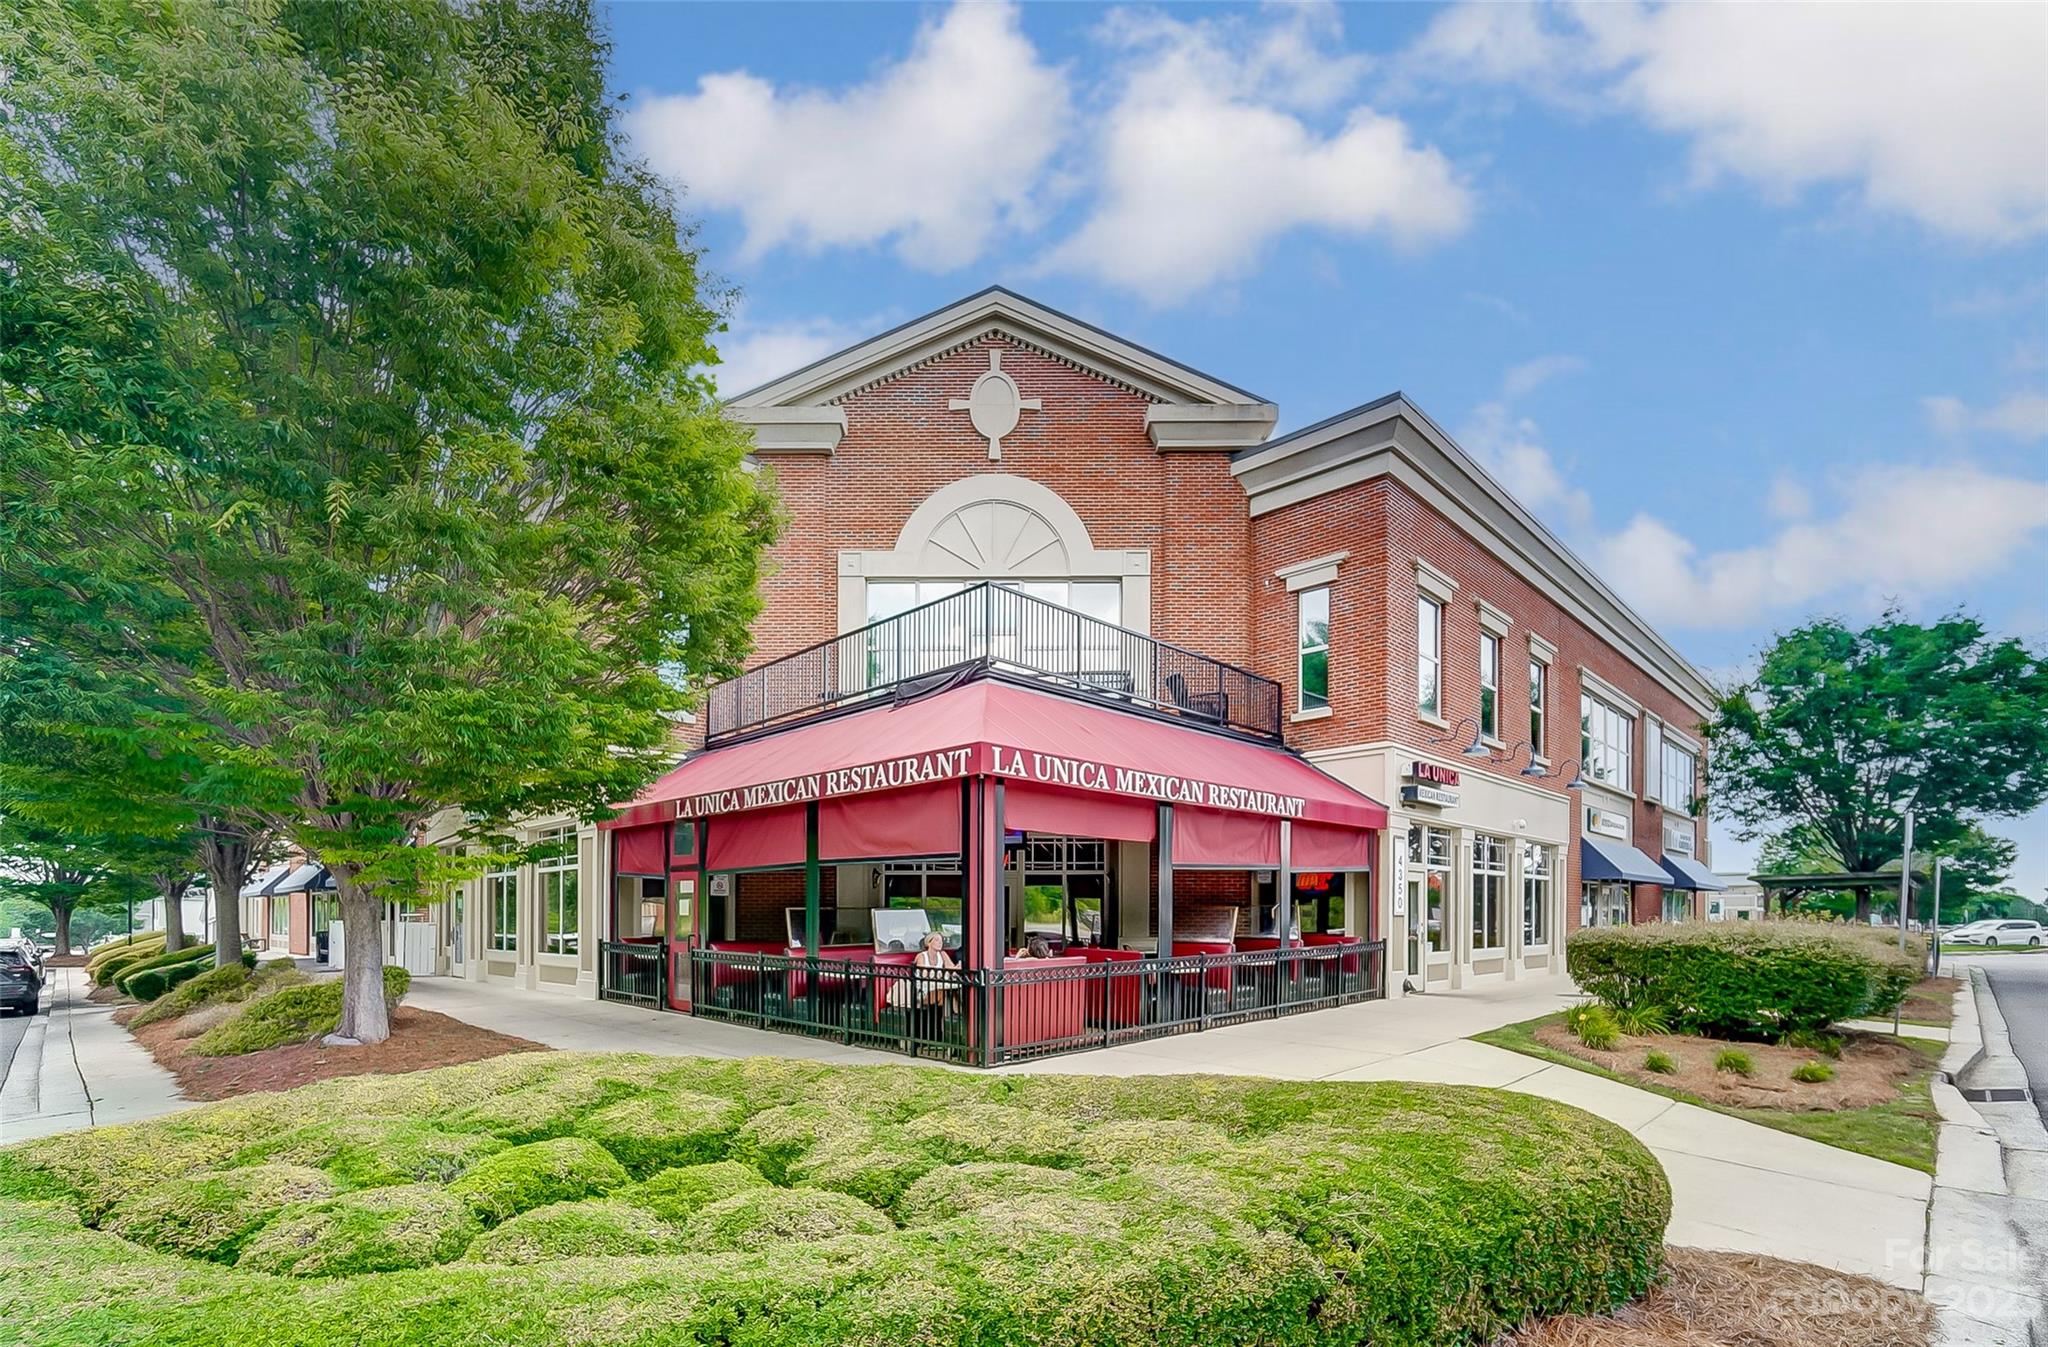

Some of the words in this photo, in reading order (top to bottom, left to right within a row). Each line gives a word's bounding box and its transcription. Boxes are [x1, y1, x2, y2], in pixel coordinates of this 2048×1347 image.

[675, 799, 693, 819] LA
[696, 791, 740, 816] UNICA
[743, 775, 821, 808] MEXICAN
[825, 748, 972, 795] RESTAURANT
[992, 746, 1028, 777] LA
[1034, 753, 1110, 790] UNICA
[1115, 767, 1204, 803] MEXICAN
[1207, 784, 1306, 818] RESTAURANT
[1418, 762, 1431, 780] LA
[1432, 766, 1461, 786] UNICA
